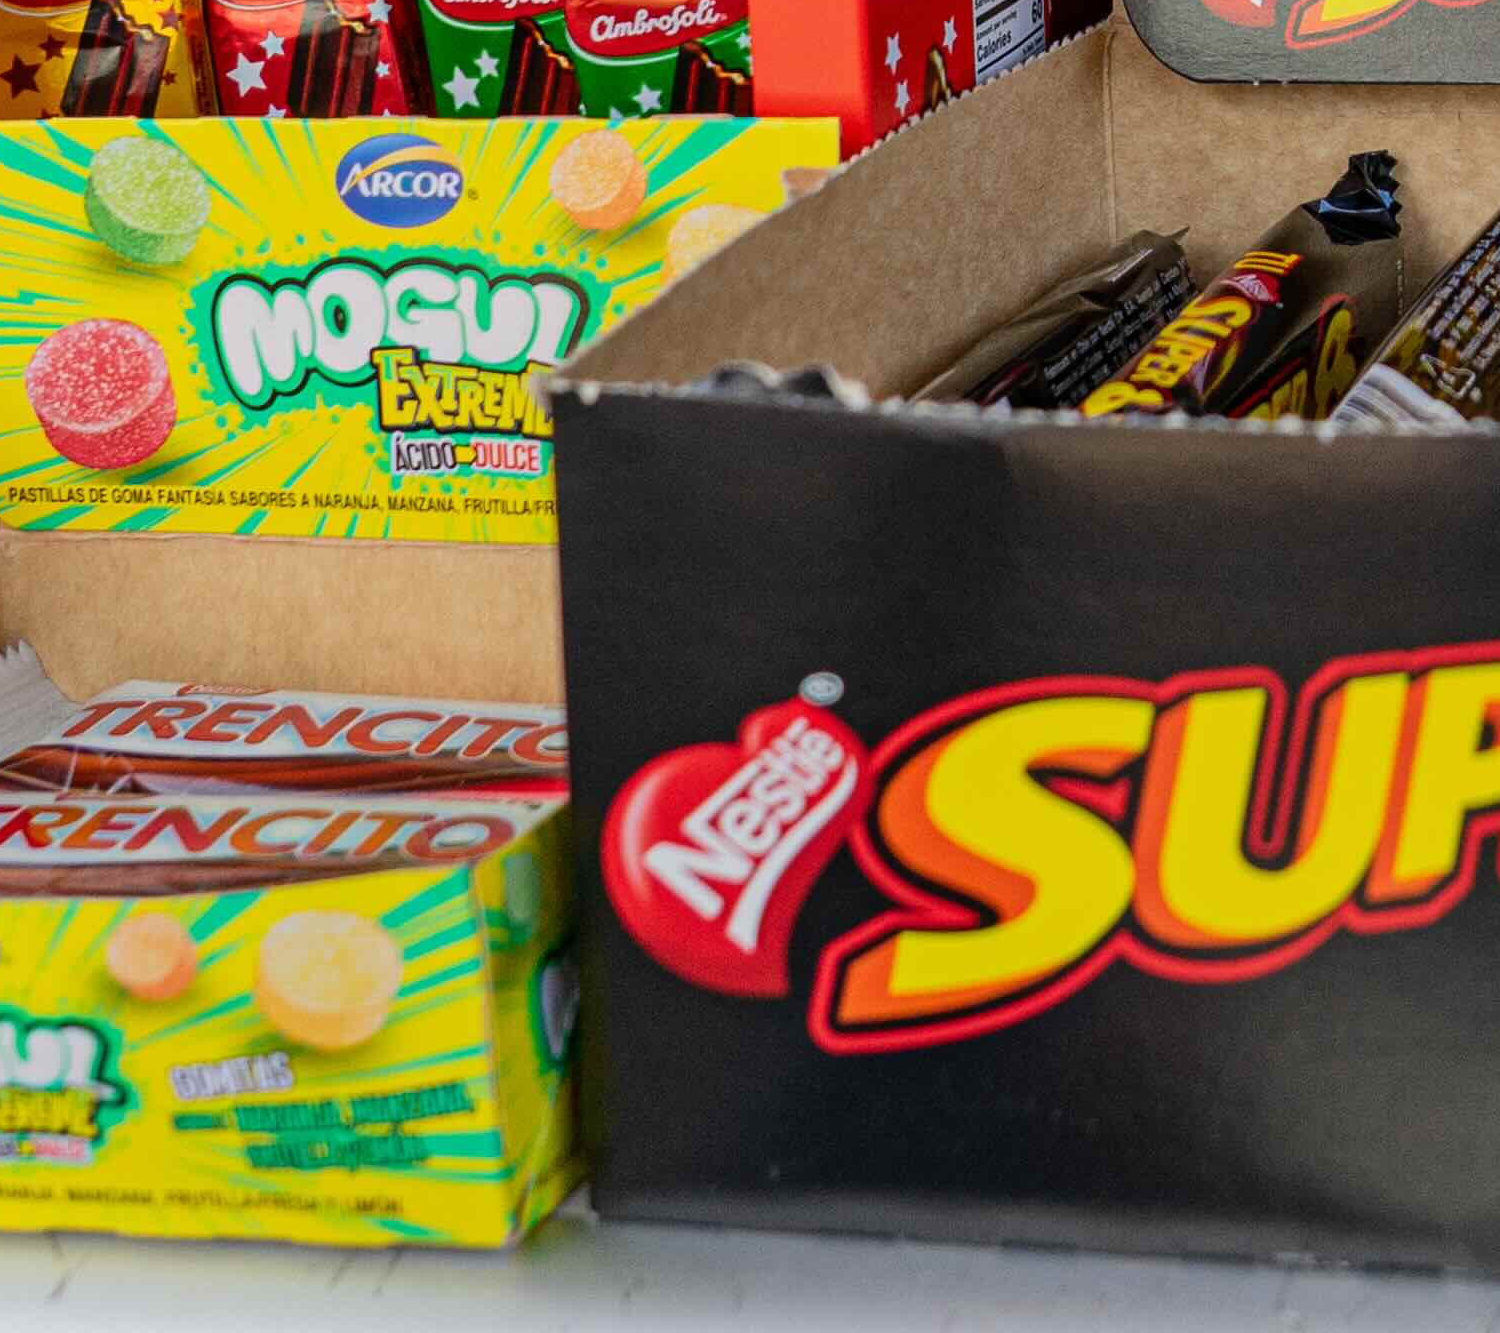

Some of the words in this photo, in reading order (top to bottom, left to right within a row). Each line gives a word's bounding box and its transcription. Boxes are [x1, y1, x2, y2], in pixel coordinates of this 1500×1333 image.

[977, 29, 1012, 63] Calories
[339, 153, 460, 200] ARCOR
[213, 257, 582, 411] MOGUL
[394, 435, 457, 472] ÁCIDO
[472, 442, 540, 471] DULCE
[8, 487, 86, 505] PASTILLAS
[89, 488, 107, 504] DE
[111, 488, 154, 505] GOMA
[229, 491, 297, 509] SABORES
[301, 493, 311, 509] A
[314, 493, 384, 511] NARANJA,
[387, 496, 460, 514] MANZANA,
[646, 711, 850, 919] Nestlé
